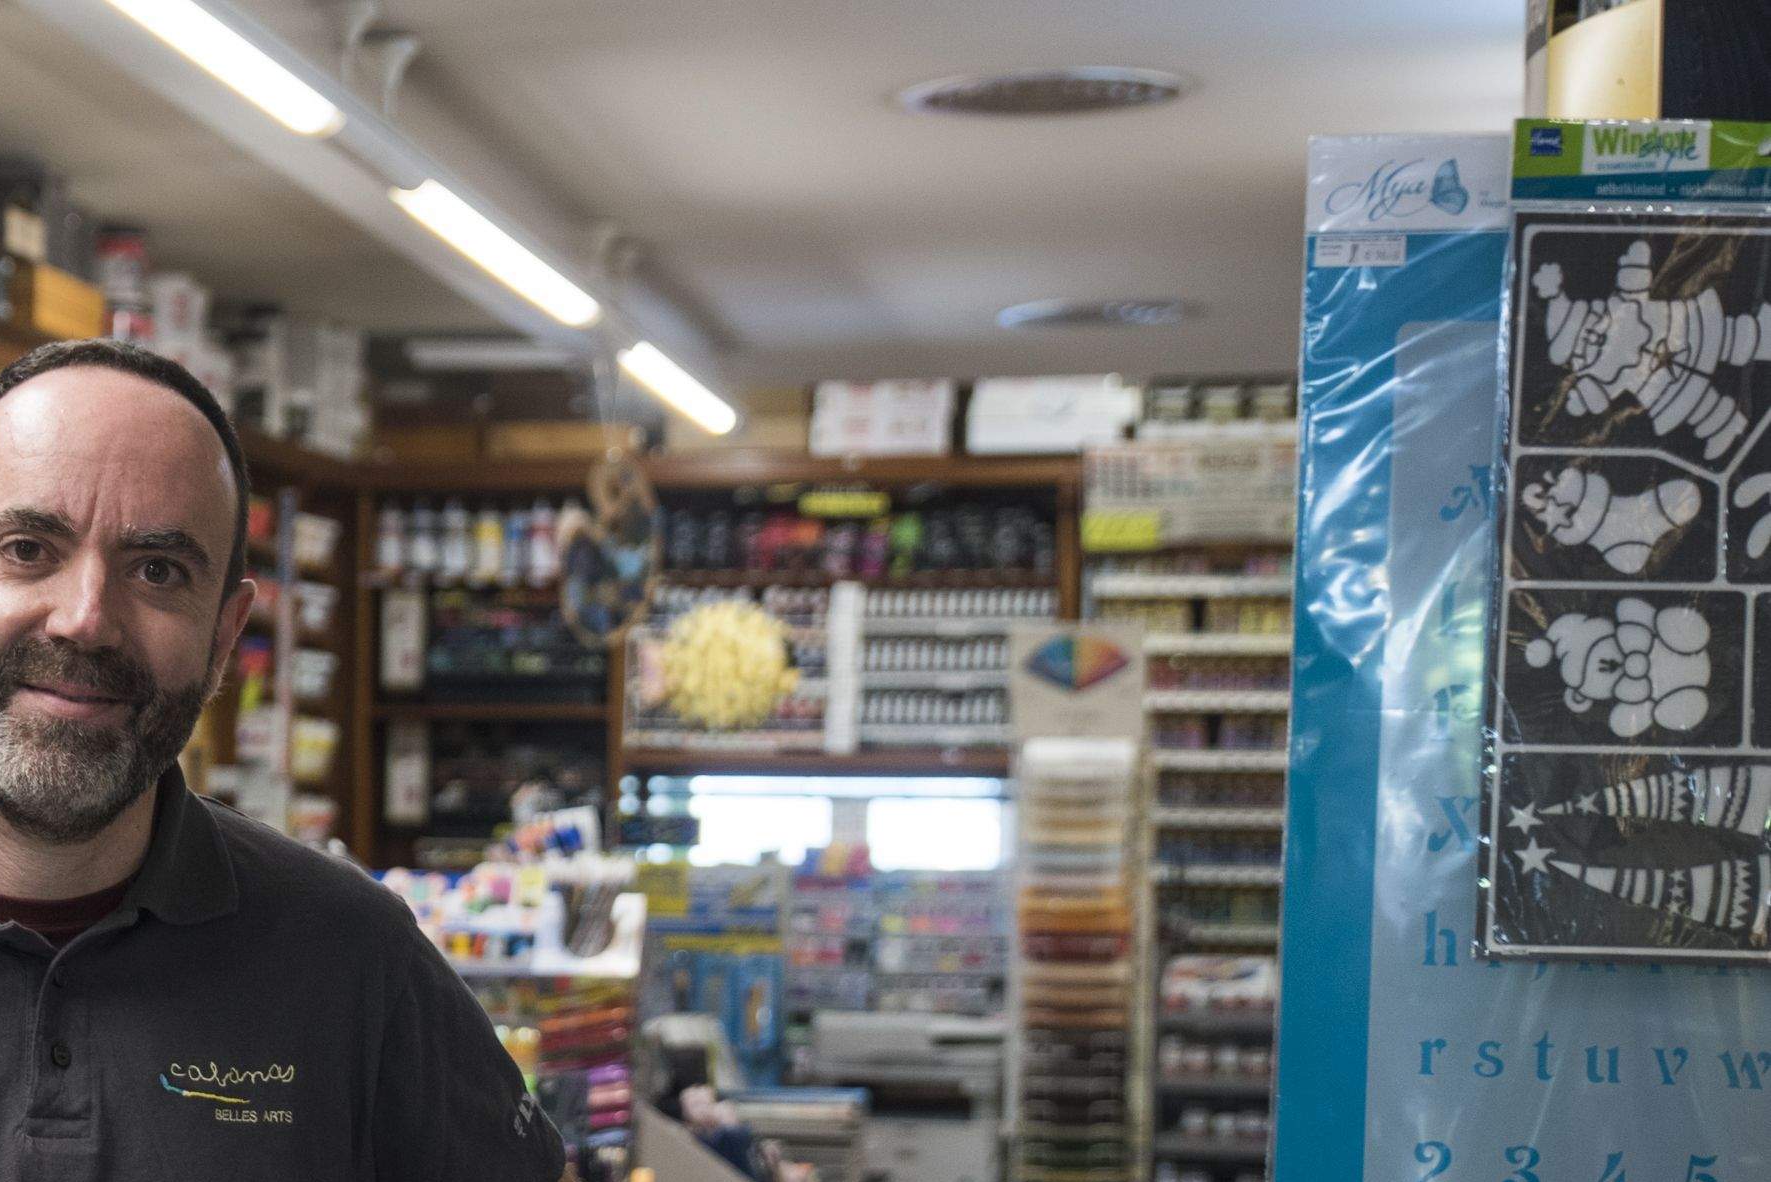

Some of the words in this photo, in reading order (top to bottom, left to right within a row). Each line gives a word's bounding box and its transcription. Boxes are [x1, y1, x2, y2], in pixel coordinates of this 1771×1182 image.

[1422, 911, 1458, 967] h
[1418, 1038, 1447, 1076] r
[1474, 1040, 1505, 1078] s
[1533, 1030, 1556, 1082] t
[1585, 1045, 1622, 1084] u
[1651, 1047, 1690, 1086] v
[214, 1108, 257, 1123] BELLES
[263, 1110, 293, 1123] ARTS
